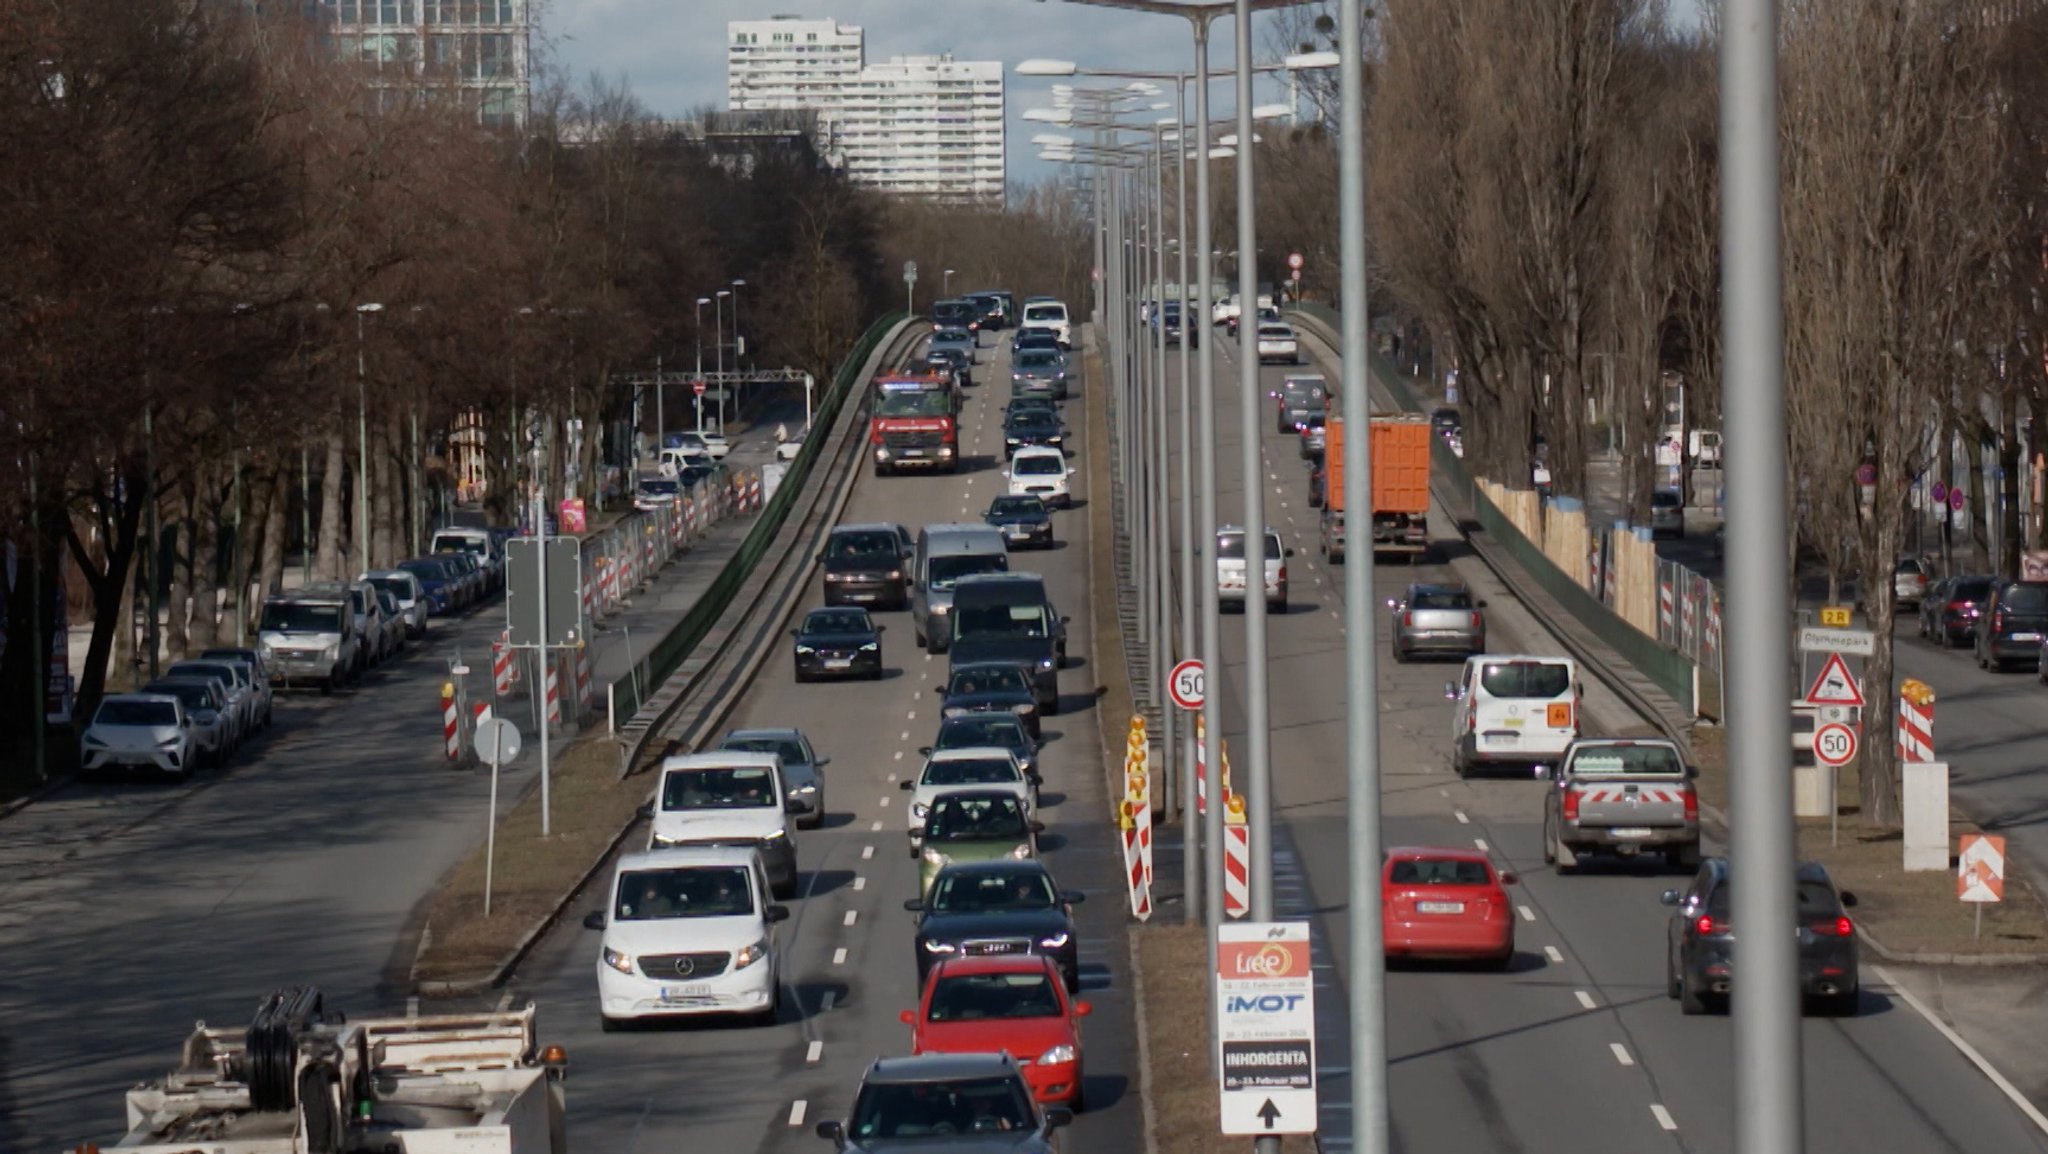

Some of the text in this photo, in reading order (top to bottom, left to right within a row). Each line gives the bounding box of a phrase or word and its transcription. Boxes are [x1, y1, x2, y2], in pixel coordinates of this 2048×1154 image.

[1181, 673, 1204, 695] 50
[1825, 734, 1847, 752] 50
[1225, 1050, 1308, 1066] INHORGENTA
